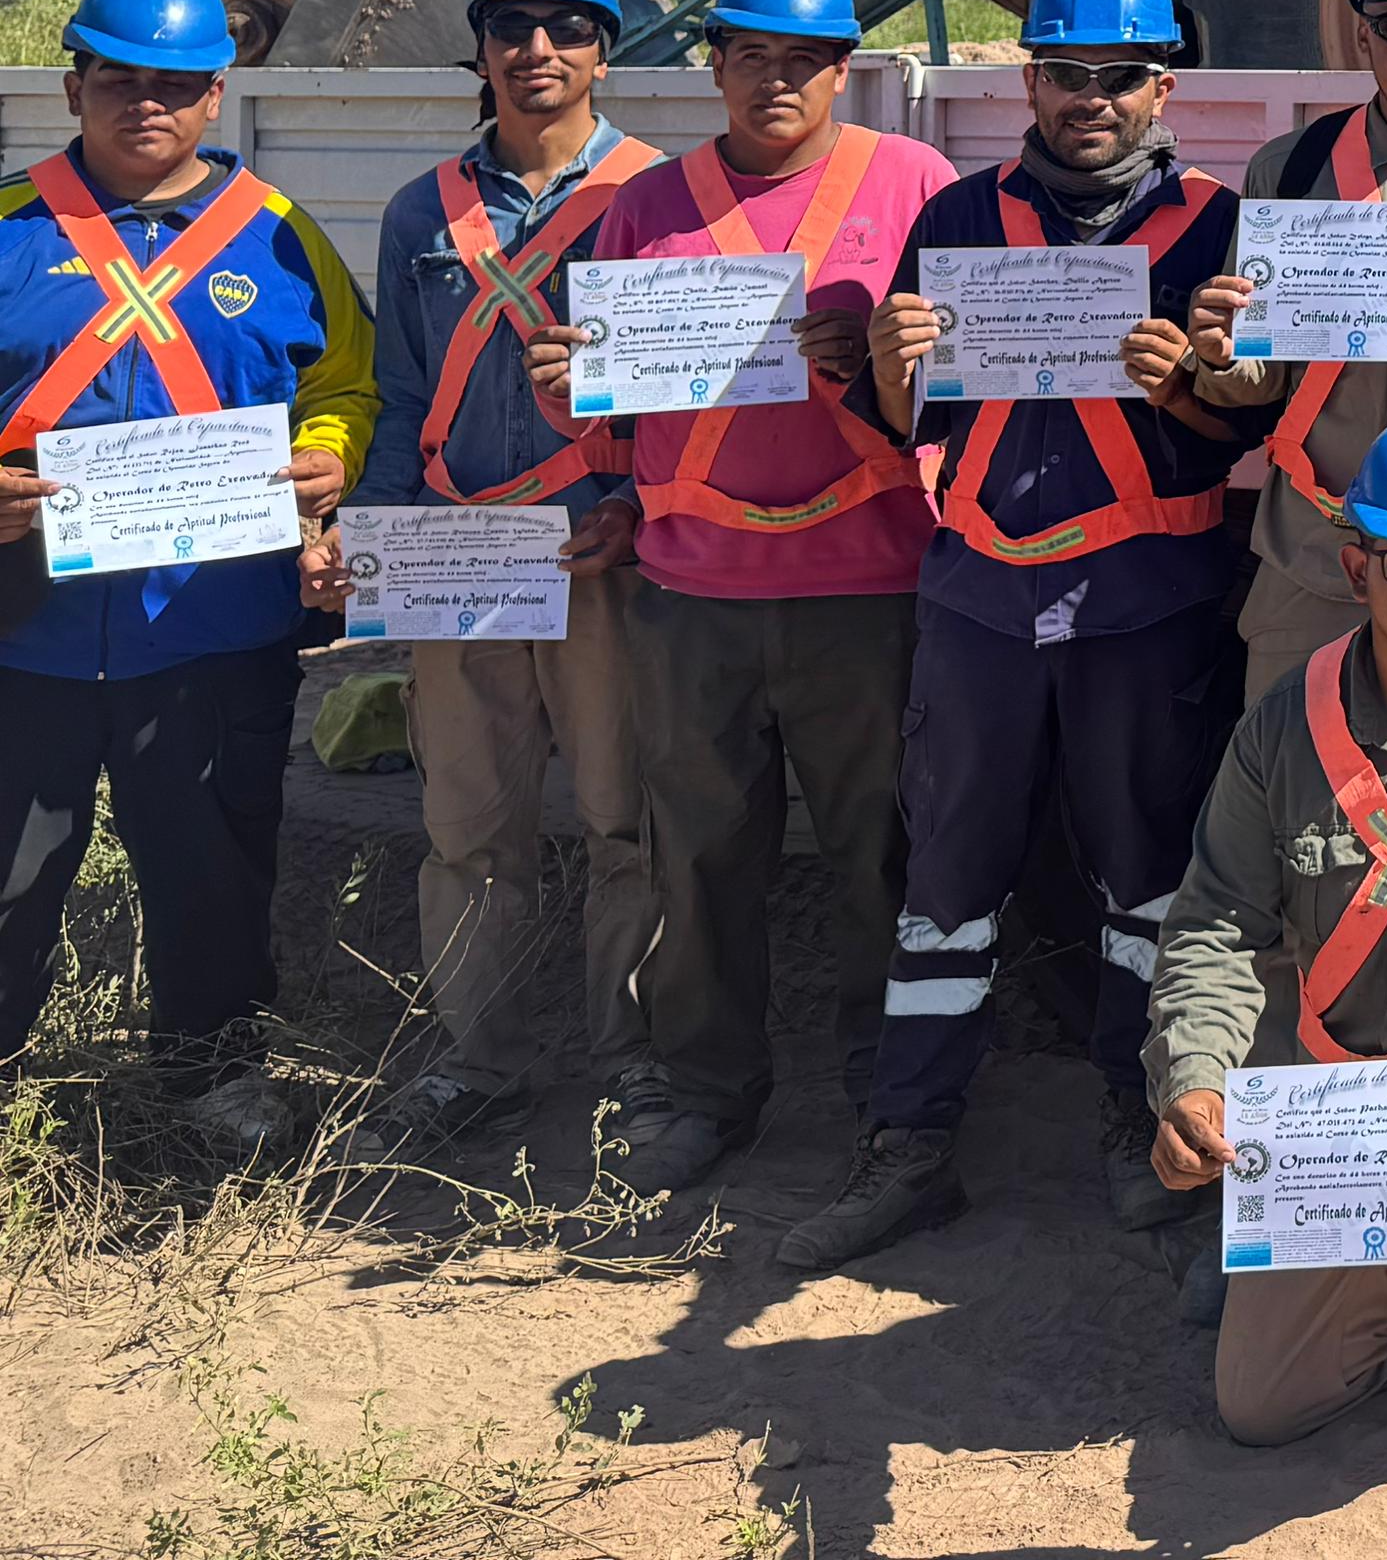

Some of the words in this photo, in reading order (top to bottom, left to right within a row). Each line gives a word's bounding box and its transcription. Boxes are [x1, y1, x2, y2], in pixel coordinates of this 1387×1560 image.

[1280, 265, 1339, 279] Operador
[1341, 266, 1355, 277] de
[1078, 310, 1143, 324] Excavadora
[1290, 308, 1340, 327] Certificado
[1340, 309, 1351, 323] de
[1288, 1066, 1366, 1106] Certificado
[1278, 1151, 1349, 1170] Operador
[1352, 1150, 1369, 1163] de
[1293, 1202, 1352, 1226] Certificado
[1354, 1201, 1366, 1218] de
